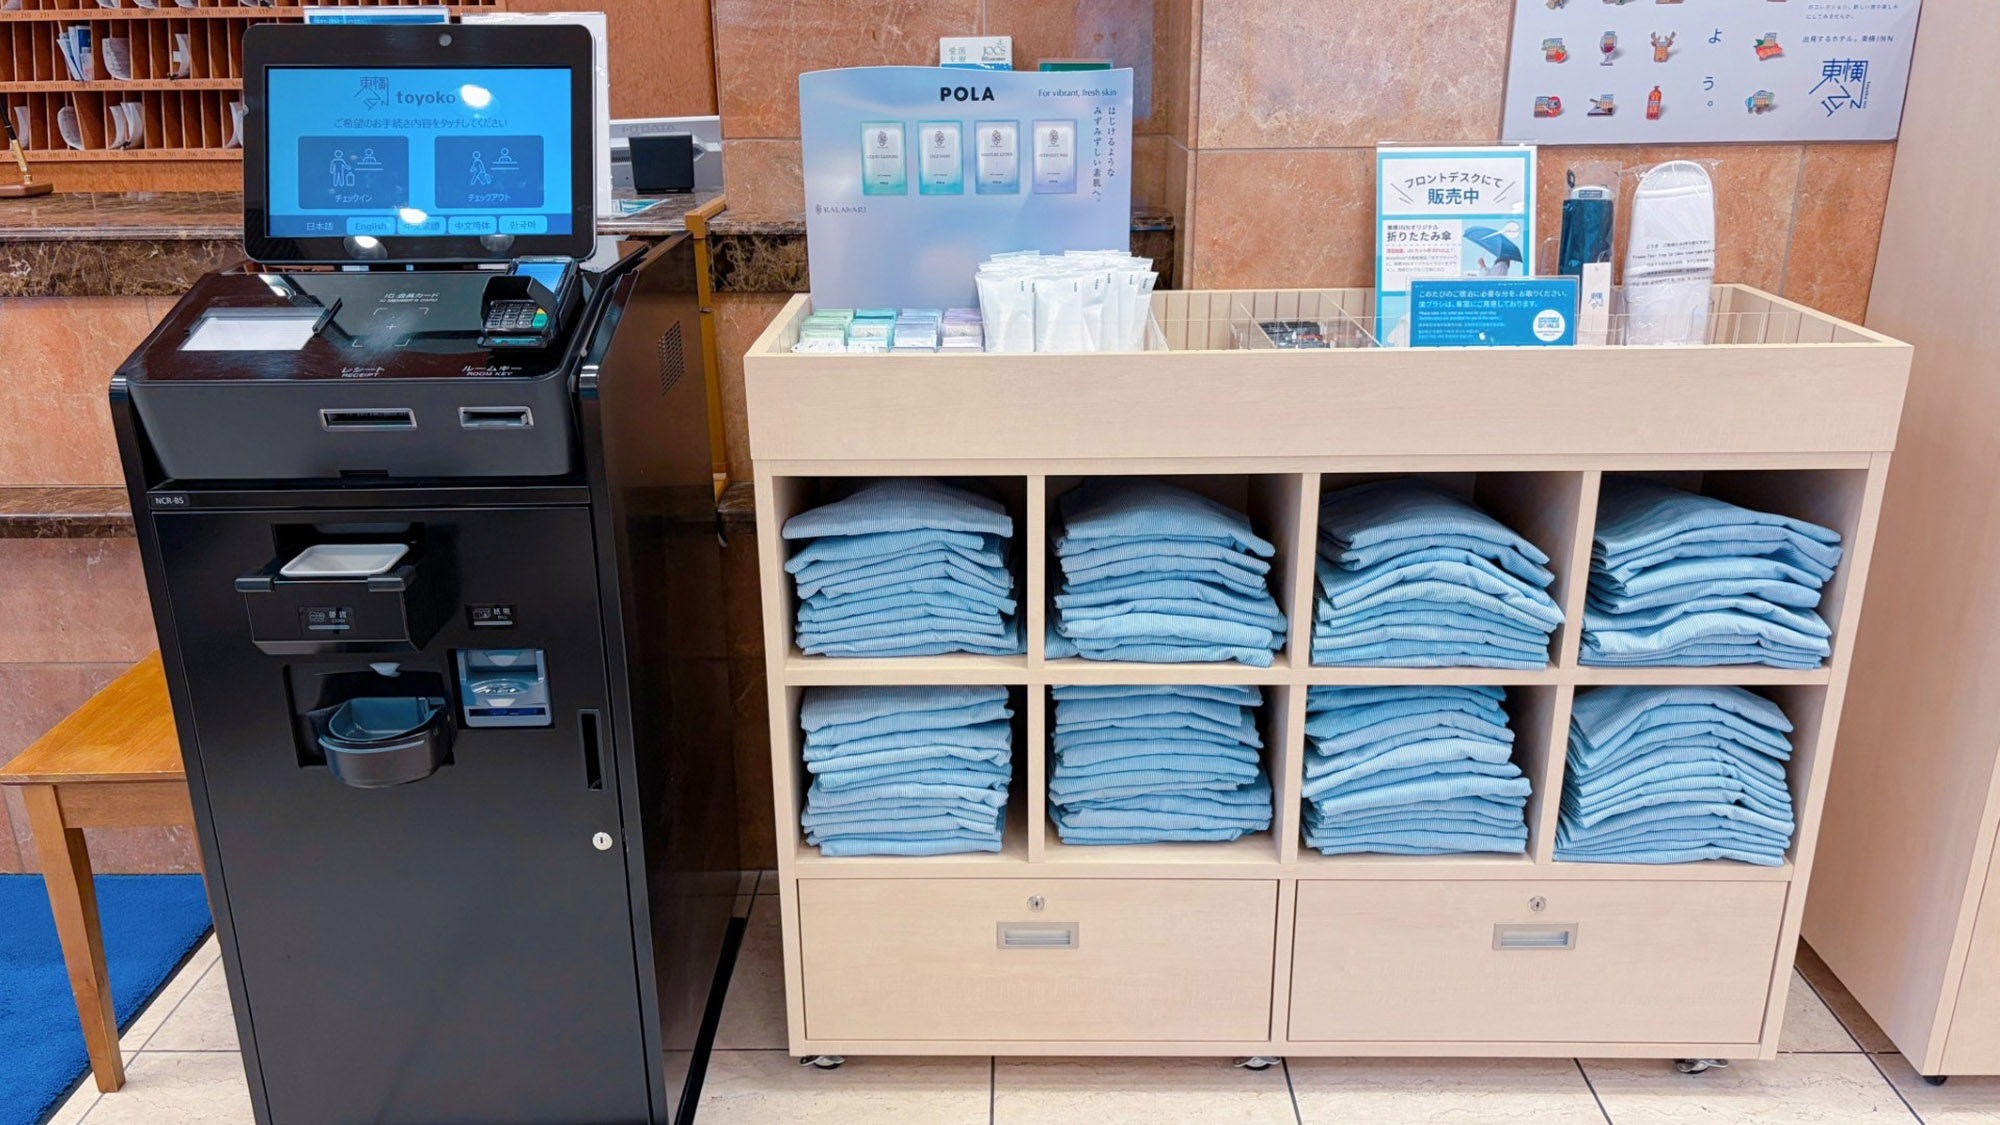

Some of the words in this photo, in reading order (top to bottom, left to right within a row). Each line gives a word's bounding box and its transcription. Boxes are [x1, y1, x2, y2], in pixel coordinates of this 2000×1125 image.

[397, 91, 456, 106] toyoko
[940, 87, 995, 102] POLA
[1038, 89, 1051, 97] For
[1051, 89, 1080, 98] vibrant,
[1082, 88, 1101, 97] fresh
[1102, 88, 1117, 96] skin
[334, 118, 508, 129] ご希望のお手続き内容をタッチしてください
[1107, 107, 1116, 177] はじけるような
[1092, 107, 1102, 202] みずみずしい素肌へ。
[1405, 172, 1503, 188] フロントデスクにて
[335, 193, 372, 203] チェックイン
[468, 193, 511, 202] チェックアウト
[1427, 187, 1479, 205] 販売中
[306, 222, 333, 231] 日本語
[355, 222, 388, 232] English
[509, 220, 537, 230] 한국어
[1387, 230, 1452, 242] 折りたたみ傘
[155, 496, 184, 505] NCR-BS
